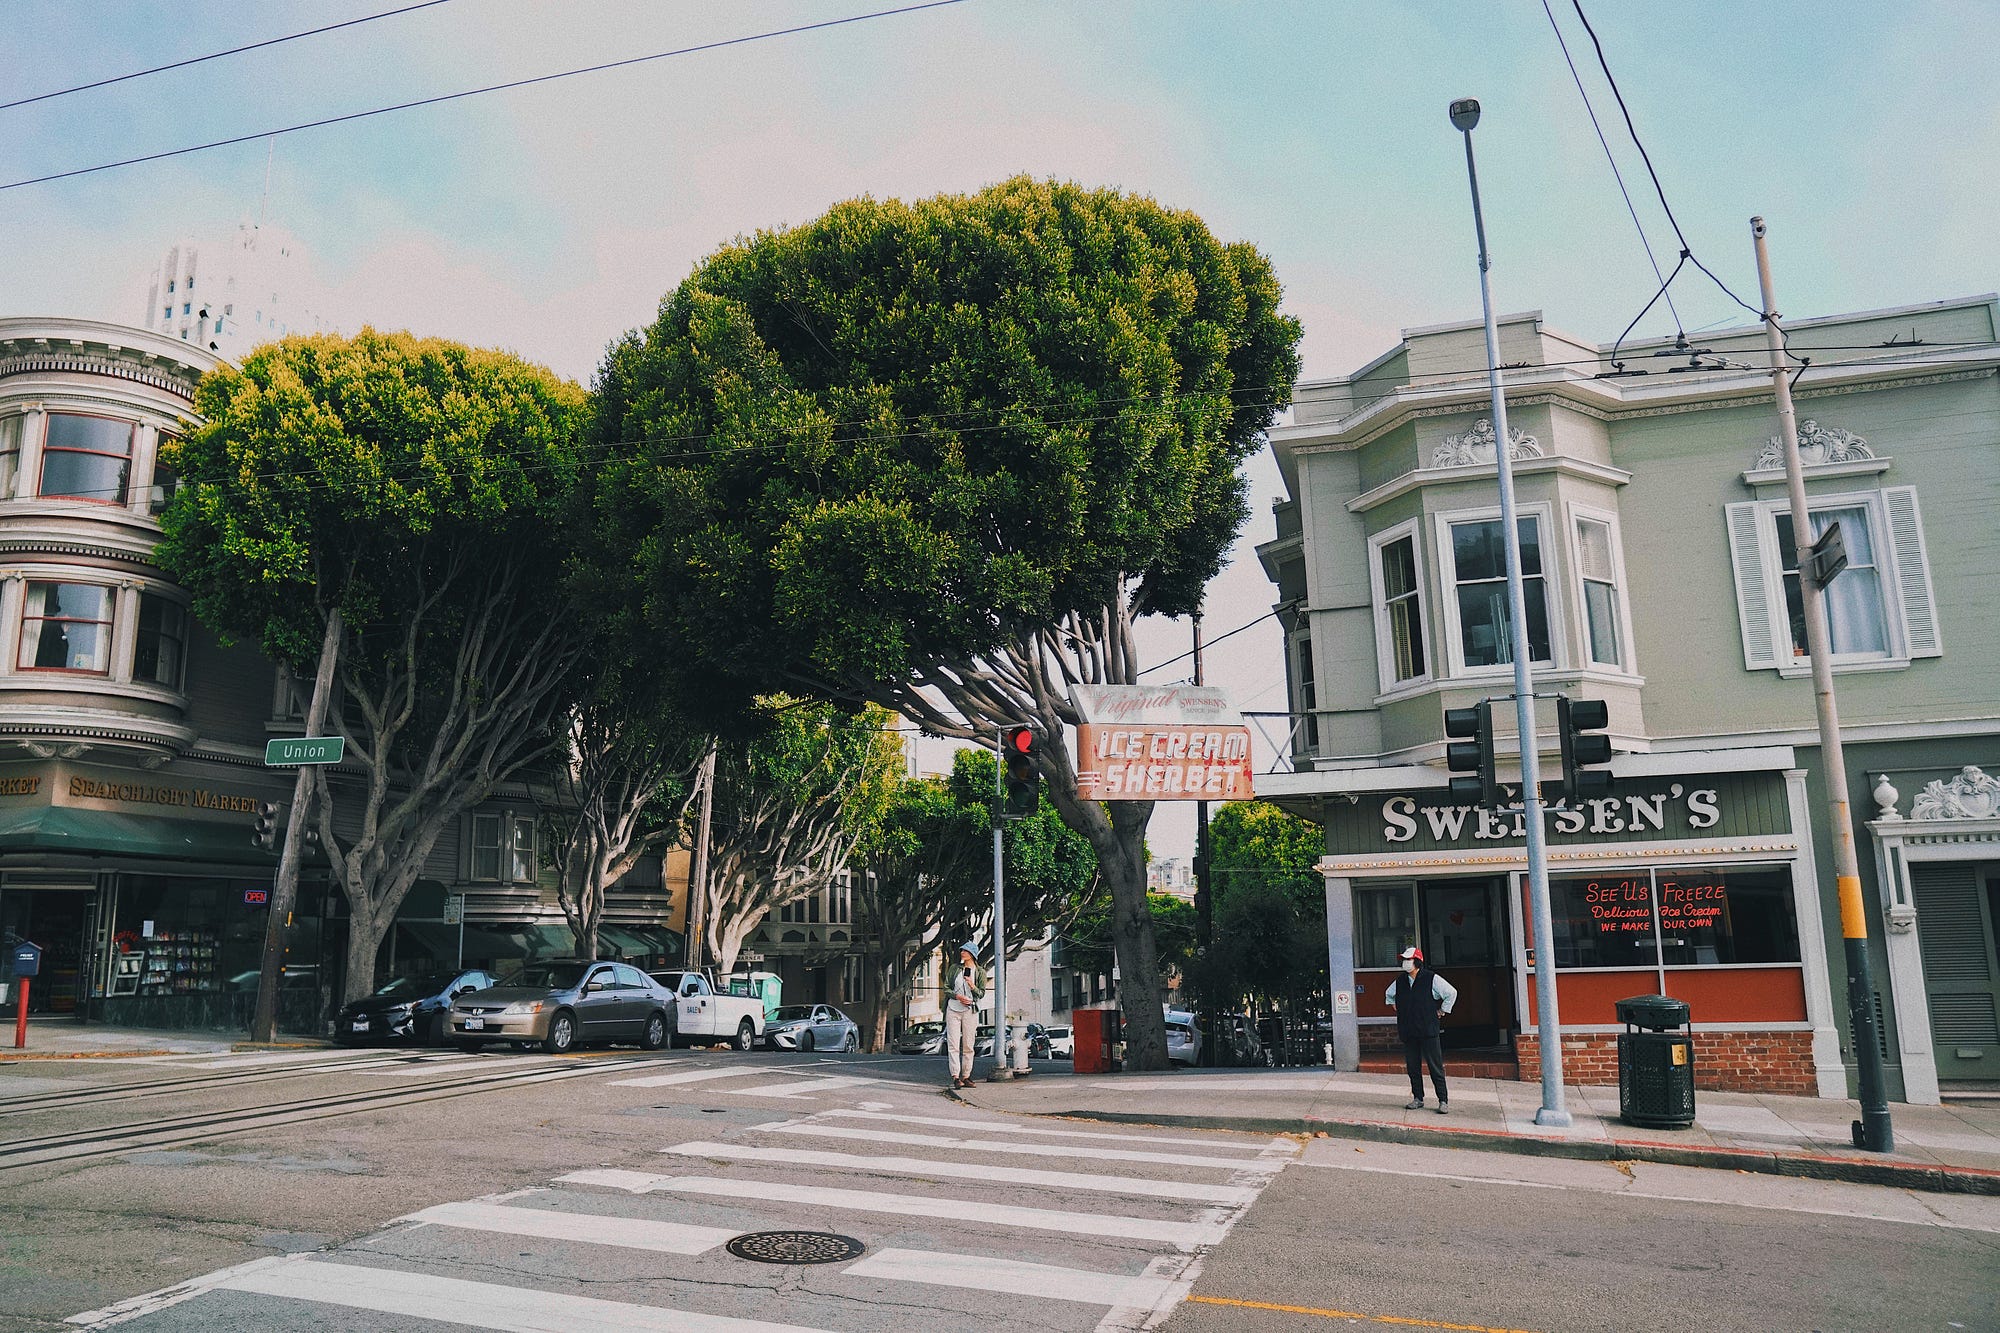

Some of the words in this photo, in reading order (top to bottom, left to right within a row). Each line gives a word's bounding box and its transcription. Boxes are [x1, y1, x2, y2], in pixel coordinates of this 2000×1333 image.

[1093, 688, 1179, 722] Original
[284, 745, 325, 758] Union
[1098, 731, 1145, 760] ICE
[1149, 731, 1249, 760] CREAM
[1106, 765, 1241, 793] SHERBET
[69, 775, 190, 806] SEARCHLIGHT
[192, 789, 258, 813] MARKET
[247, 892, 265, 902] OPEN
[1585, 883, 1618, 903] SEE
[1663, 882, 1725, 903] FREEZE
[1591, 905, 1650, 918] Delicious
[1658, 905, 1681, 917] Ice
[1683, 903, 1722, 917] Cream
[1601, 923, 1616, 932] WE
[1621, 922, 1650, 931] MAKE
[1663, 920, 1685, 930] OUR
[1688, 917, 1713, 928] OWN
